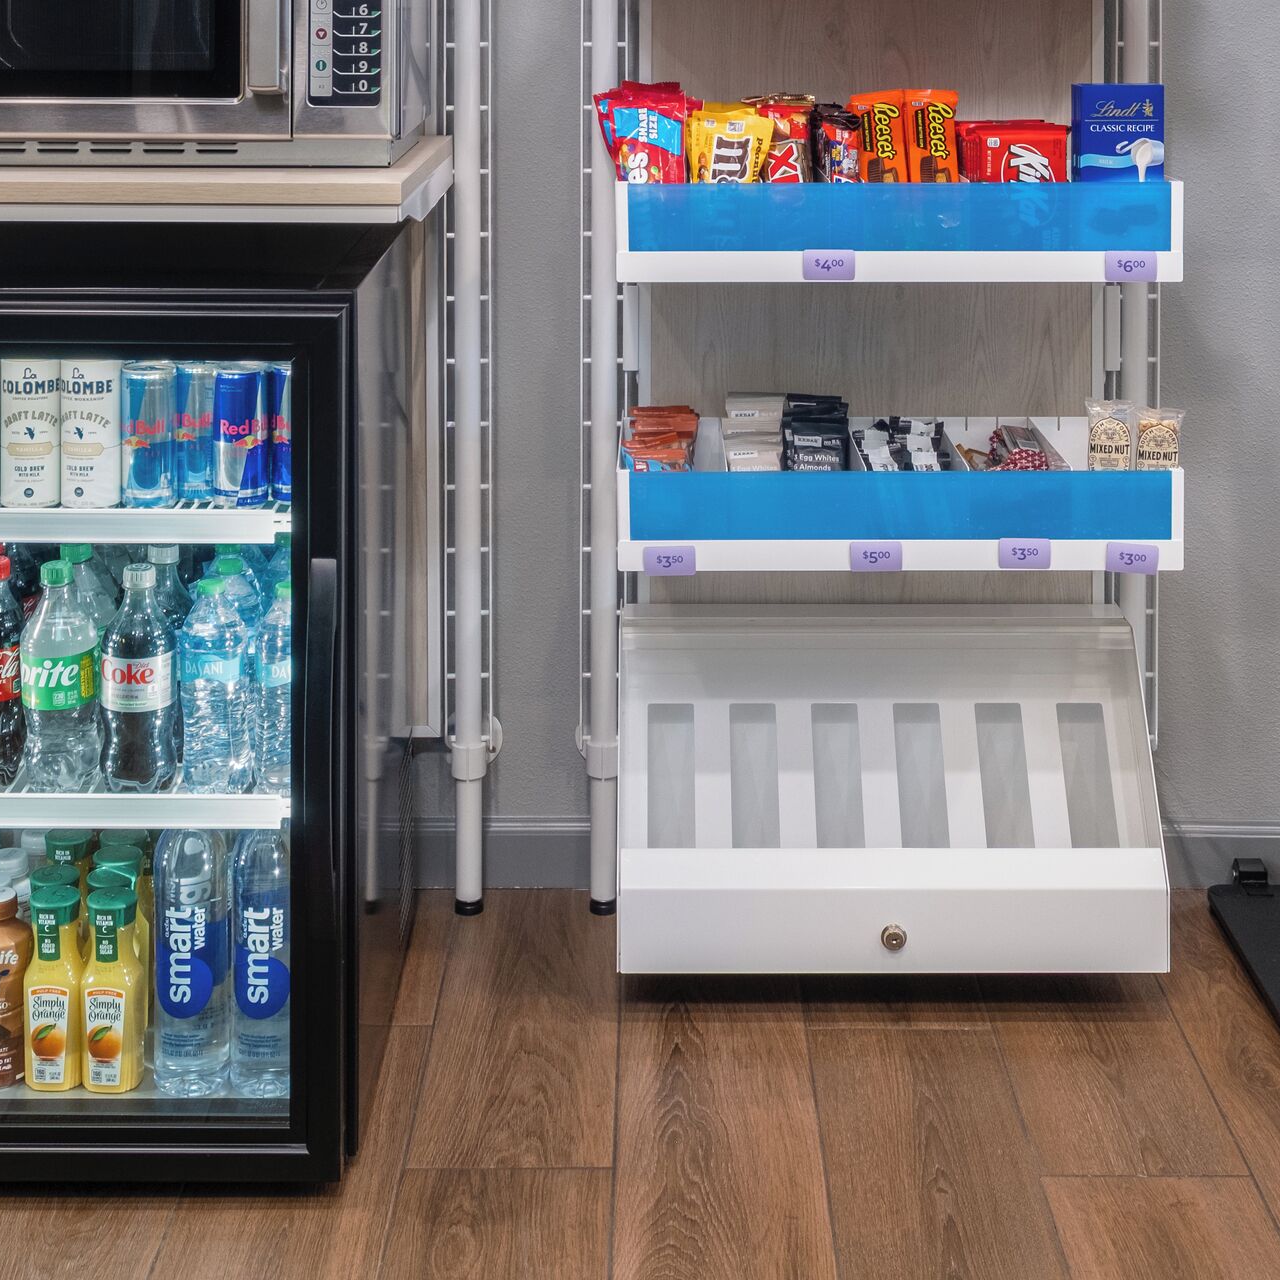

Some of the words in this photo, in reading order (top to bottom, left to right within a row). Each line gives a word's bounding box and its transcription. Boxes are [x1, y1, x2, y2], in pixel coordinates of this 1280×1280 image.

[359, 4, 368, 15] 6
[359, 23, 368, 34] 7
[359, 42, 368, 53] 8
[359, 61, 368, 72] 9
[1089, 100, 1141, 117] Lindt
[648, 115, 658, 140] SIZE
[1090, 124, 1125, 132] CLASSIC
[1127, 124, 1156, 132] RECIPE
[815, 257, 844, 271] $400
[1117, 259, 1146, 272] $600
[23, 367, 37, 379] La
[71, 367, 84, 379] La
[2, 377, 60, 395] COLOMBE
[220, 419, 249, 435] Red
[1089, 444, 1113, 454] MIXED
[1115, 444, 1130, 455] NUT
[1137, 450, 1161, 460] MIXED
[1163, 451, 1178, 462] NUT
[814, 454, 840, 462] Whites
[799, 463, 832, 471] Almonds
[862, 550, 890, 564] $500
[1011, 546, 1038, 560] $350
[1118, 551, 1146, 565] $300
[656, 554, 684, 568] $350
[101, 659, 154, 686] Coke
[165, 907, 191, 1004] smart
[194, 907, 206, 950] water
[244, 907, 270, 1004] smart
[272, 907, 284, 951] water
[32, 997, 65, 1013] Simply
[89, 998, 121, 1014] Simply
[32, 1010, 65, 1024] Orange
[88, 1011, 121, 1025] Orange
